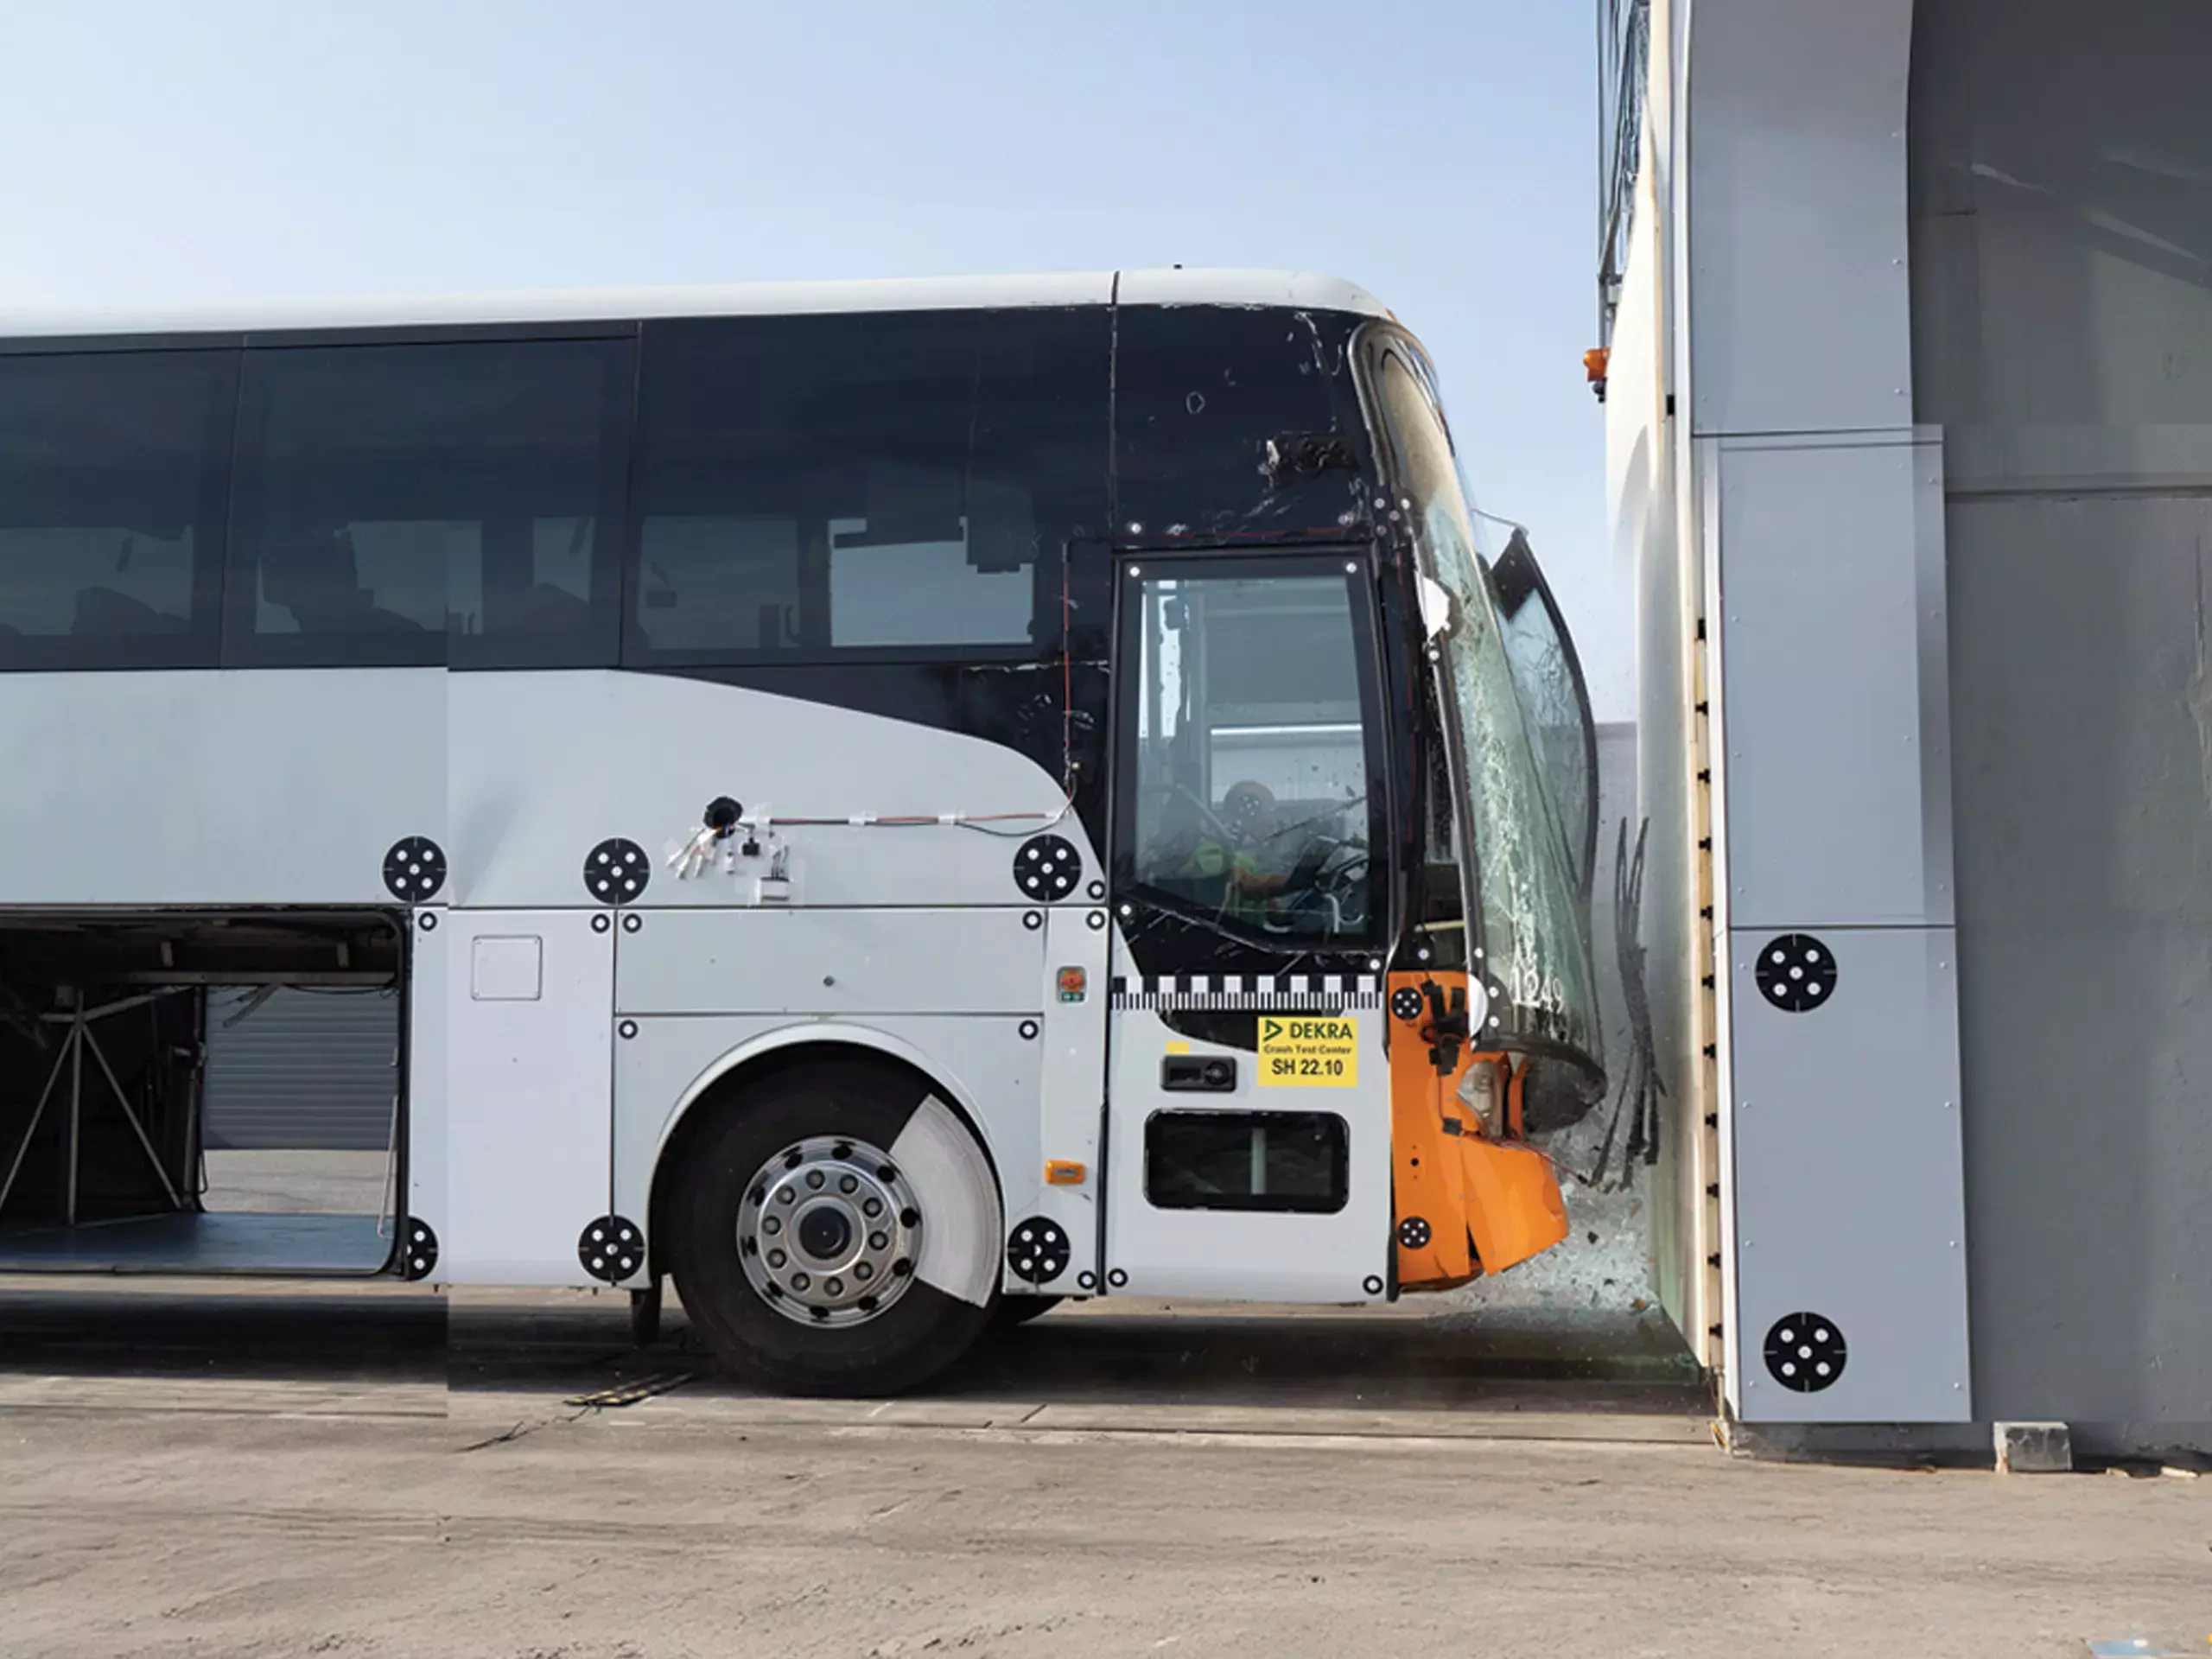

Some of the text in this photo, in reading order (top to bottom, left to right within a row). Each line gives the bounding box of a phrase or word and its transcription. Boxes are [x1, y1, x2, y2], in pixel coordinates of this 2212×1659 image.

[1290, 1022, 1353, 1039] DEKRA
[1264, 1044, 1352, 1054] Crash Test Center
[1271, 1058, 1344, 1077] SH 22.10
